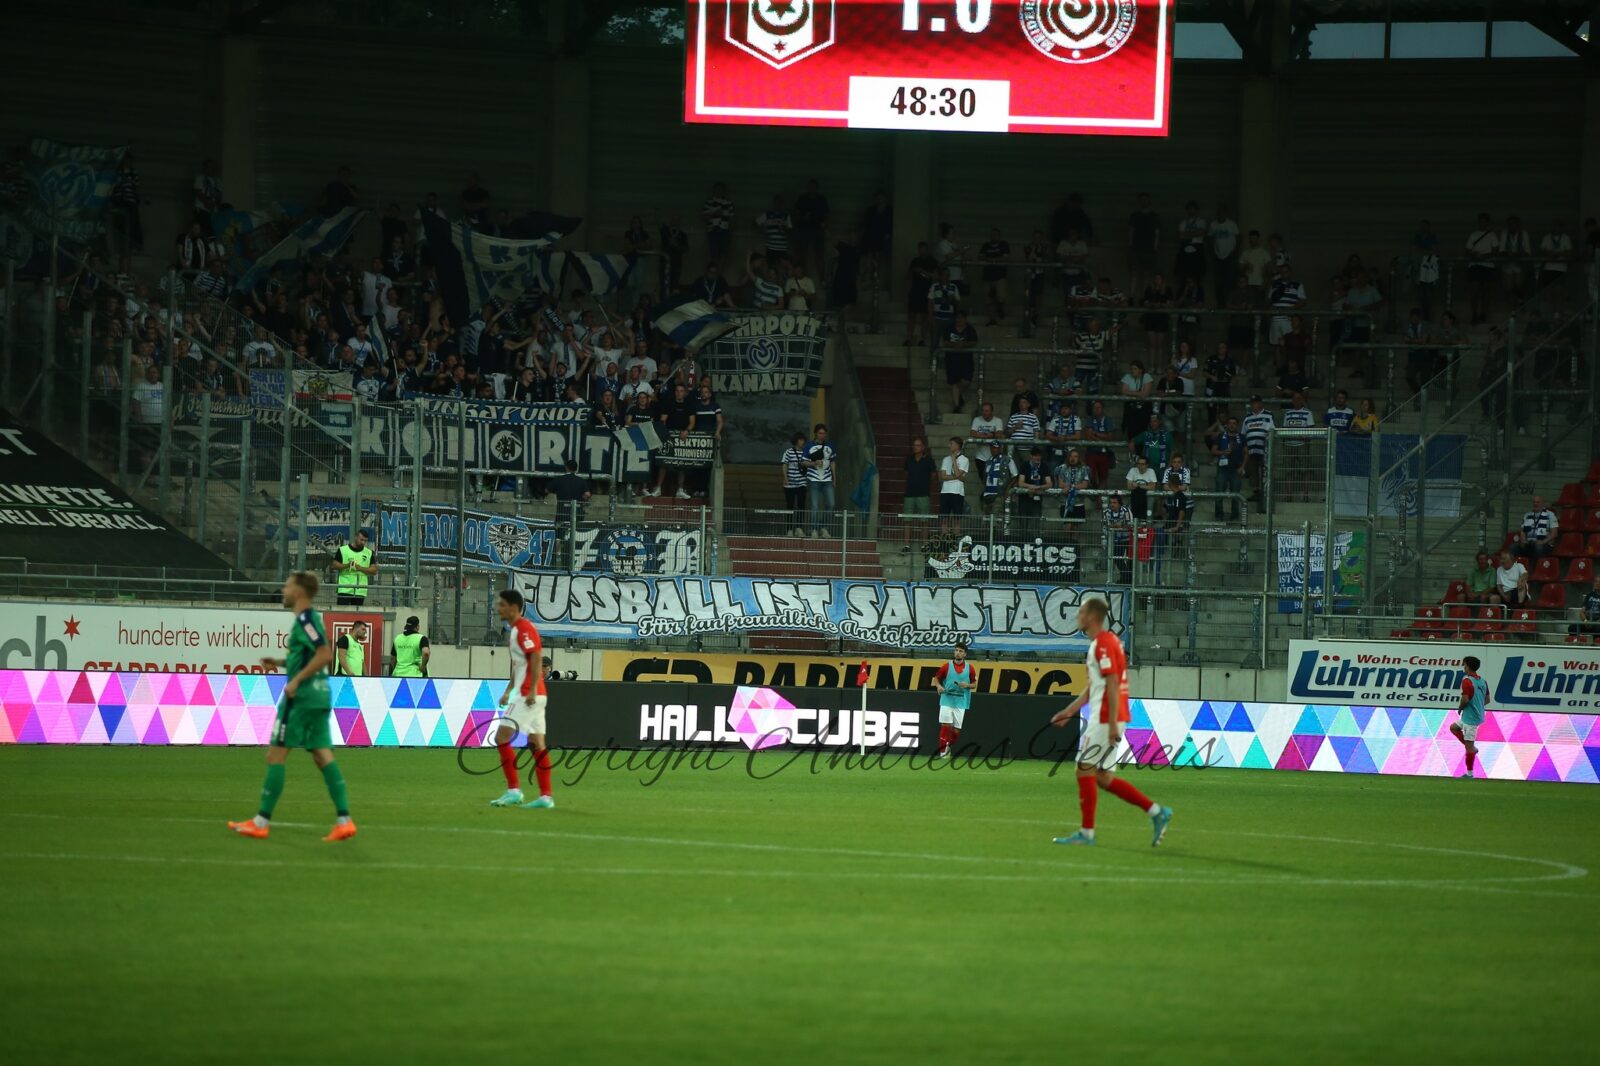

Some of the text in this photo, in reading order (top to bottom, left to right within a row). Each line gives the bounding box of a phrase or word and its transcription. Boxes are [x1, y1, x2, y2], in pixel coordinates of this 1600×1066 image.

[890, 86, 977, 117] 48:30
[529, 529, 556, 567] 47
[512, 570, 745, 625] FUSSBALL
[751, 580, 832, 622] IST
[118, 620, 200, 648] hunderte
[206, 624, 270, 649] wirklich
[638, 614, 681, 637] Für
[684, 608, 837, 636] fanfreundliche
[1360, 691, 1461, 703] an der Salin
